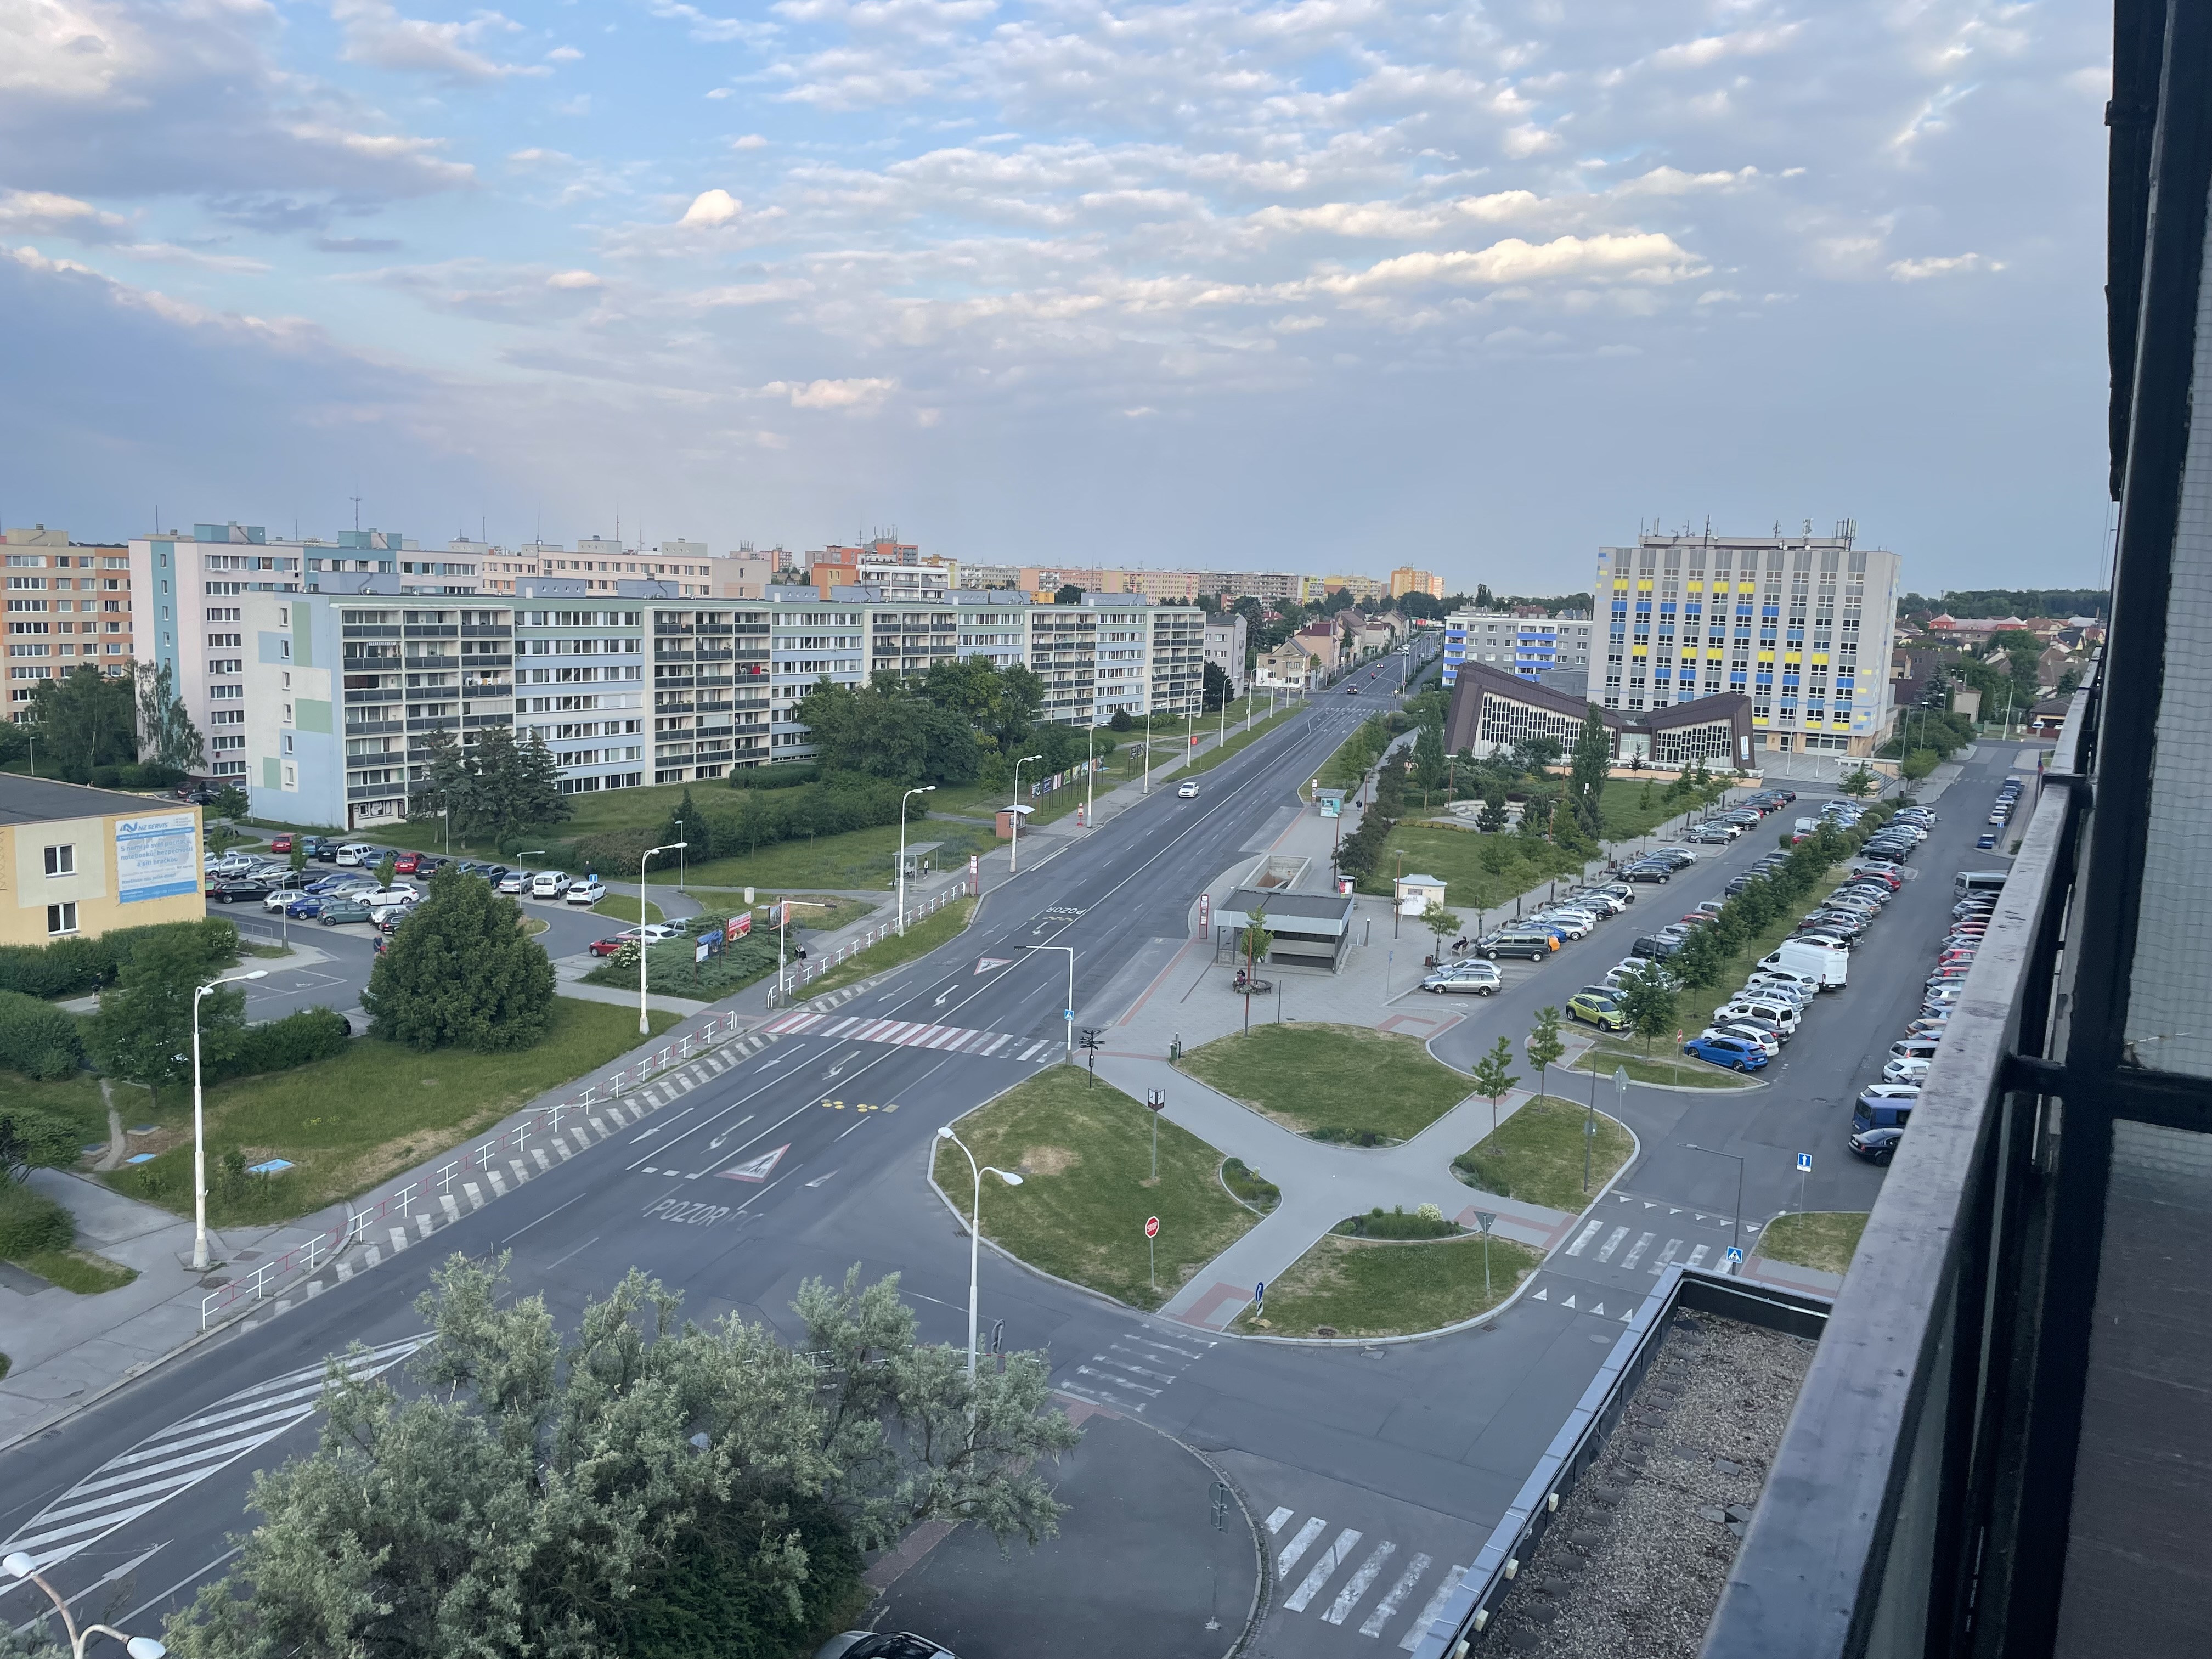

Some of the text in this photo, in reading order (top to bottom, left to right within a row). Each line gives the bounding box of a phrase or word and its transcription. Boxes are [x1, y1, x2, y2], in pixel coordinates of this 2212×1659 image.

[1046, 906, 1087, 915] POZOR
[642, 1198, 730, 1227] POZOR
[1147, 1221, 1158, 1233] STOP
